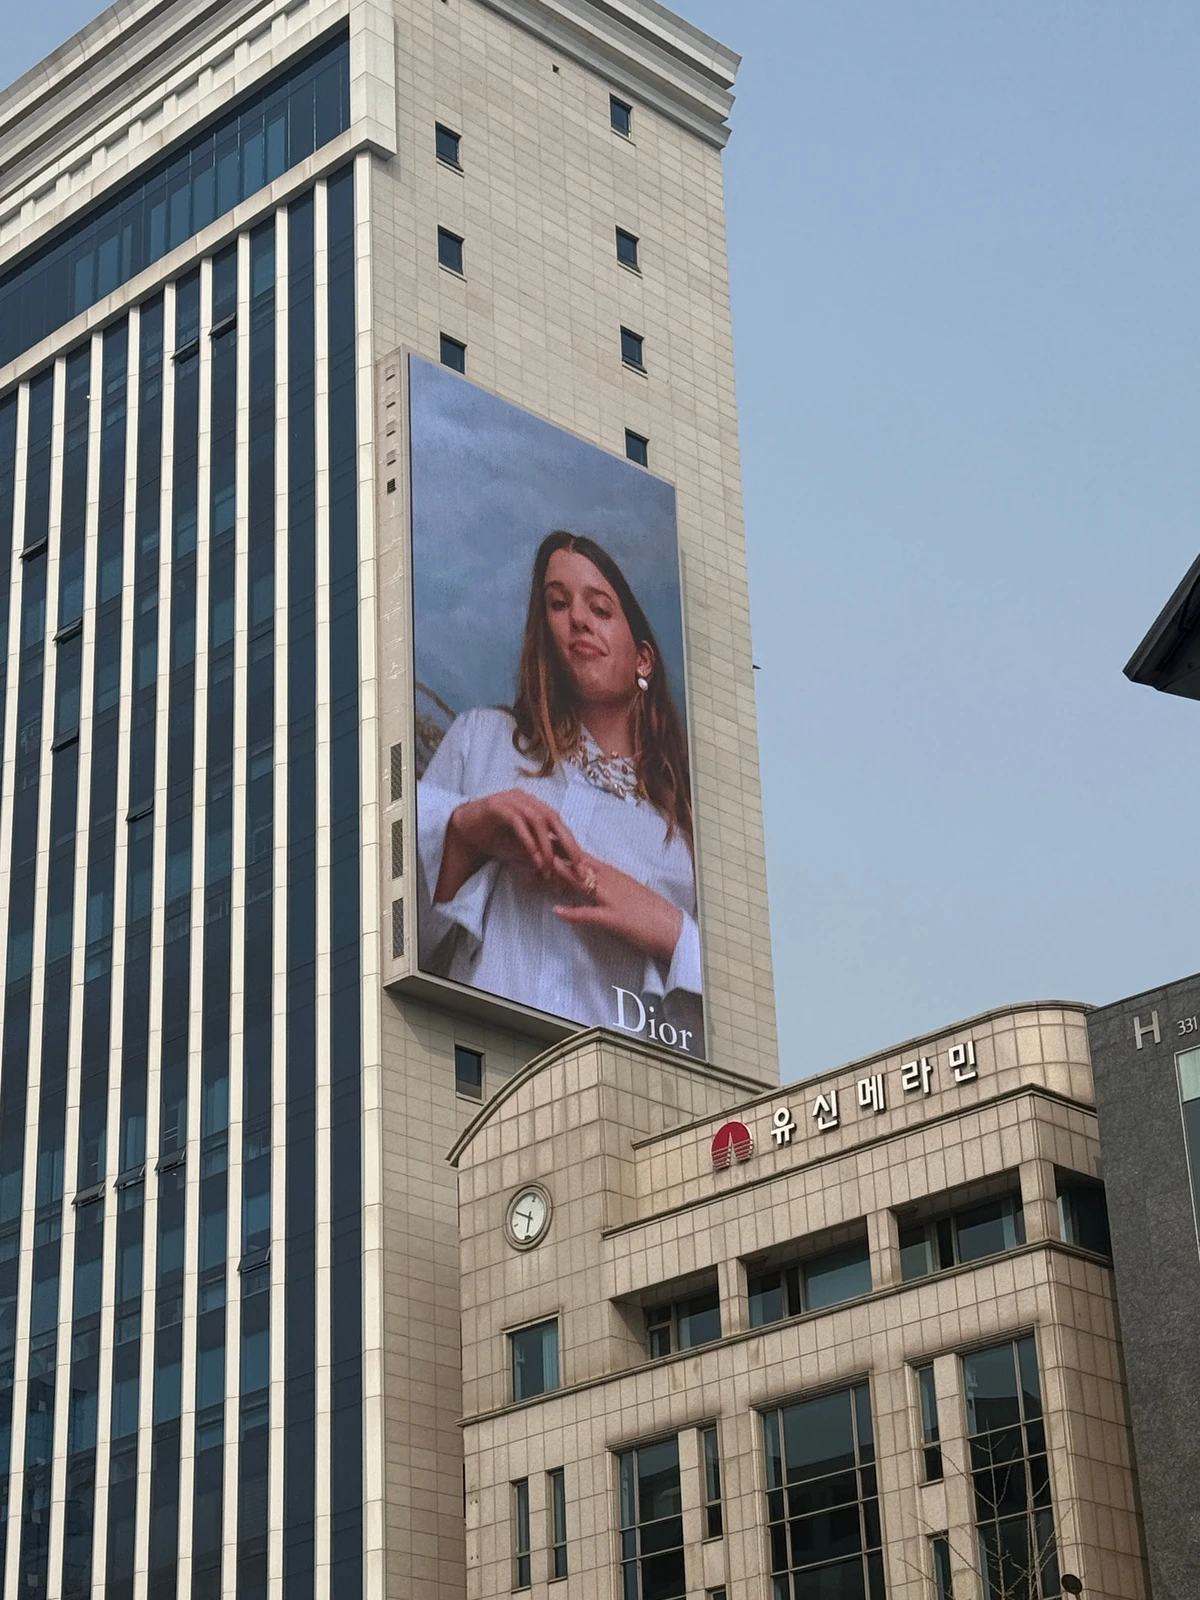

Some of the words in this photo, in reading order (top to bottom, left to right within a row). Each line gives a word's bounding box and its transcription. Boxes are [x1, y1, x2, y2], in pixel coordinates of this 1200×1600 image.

[611, 985, 693, 1052] Dior
[1133, 1010, 1161, 1050] H
[1177, 1015, 1198, 1036] 331
[770, 1040, 978, 1145] 유신메라민
